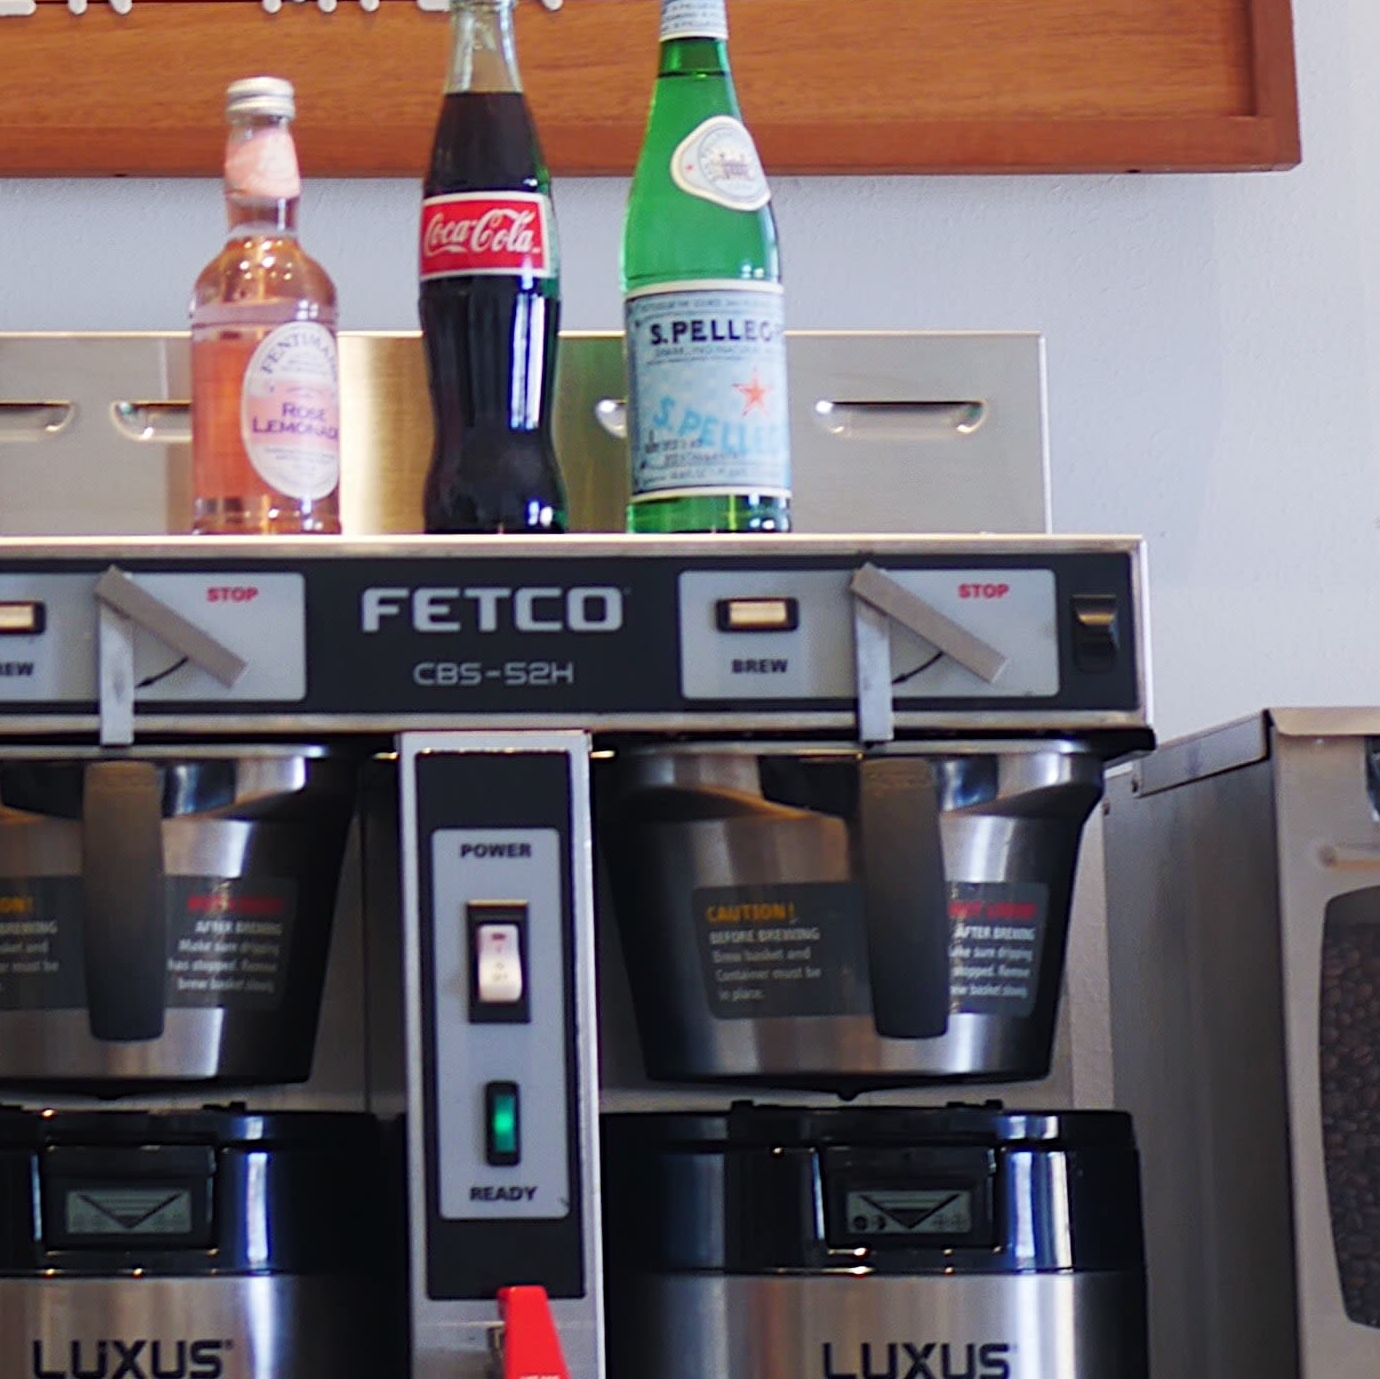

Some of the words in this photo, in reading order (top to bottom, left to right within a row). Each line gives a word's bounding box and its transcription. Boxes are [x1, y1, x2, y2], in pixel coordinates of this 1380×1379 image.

[425, 208, 534, 258] Coca-Cola
[206, 587, 258, 603] STOP
[957, 583, 1010, 600] STOP
[362, 587, 623, 632] FETCO
[413, 661, 574, 685] CBS-52H
[730, 658, 788, 675] BREW
[460, 844, 532, 859] POWER
[706, 902, 795, 923] CAUTION!
[470, 1187, 537, 1202] READY
[33, 1340, 224, 1379] LUXUS
[823, 1343, 1011, 1379] LUXUS
